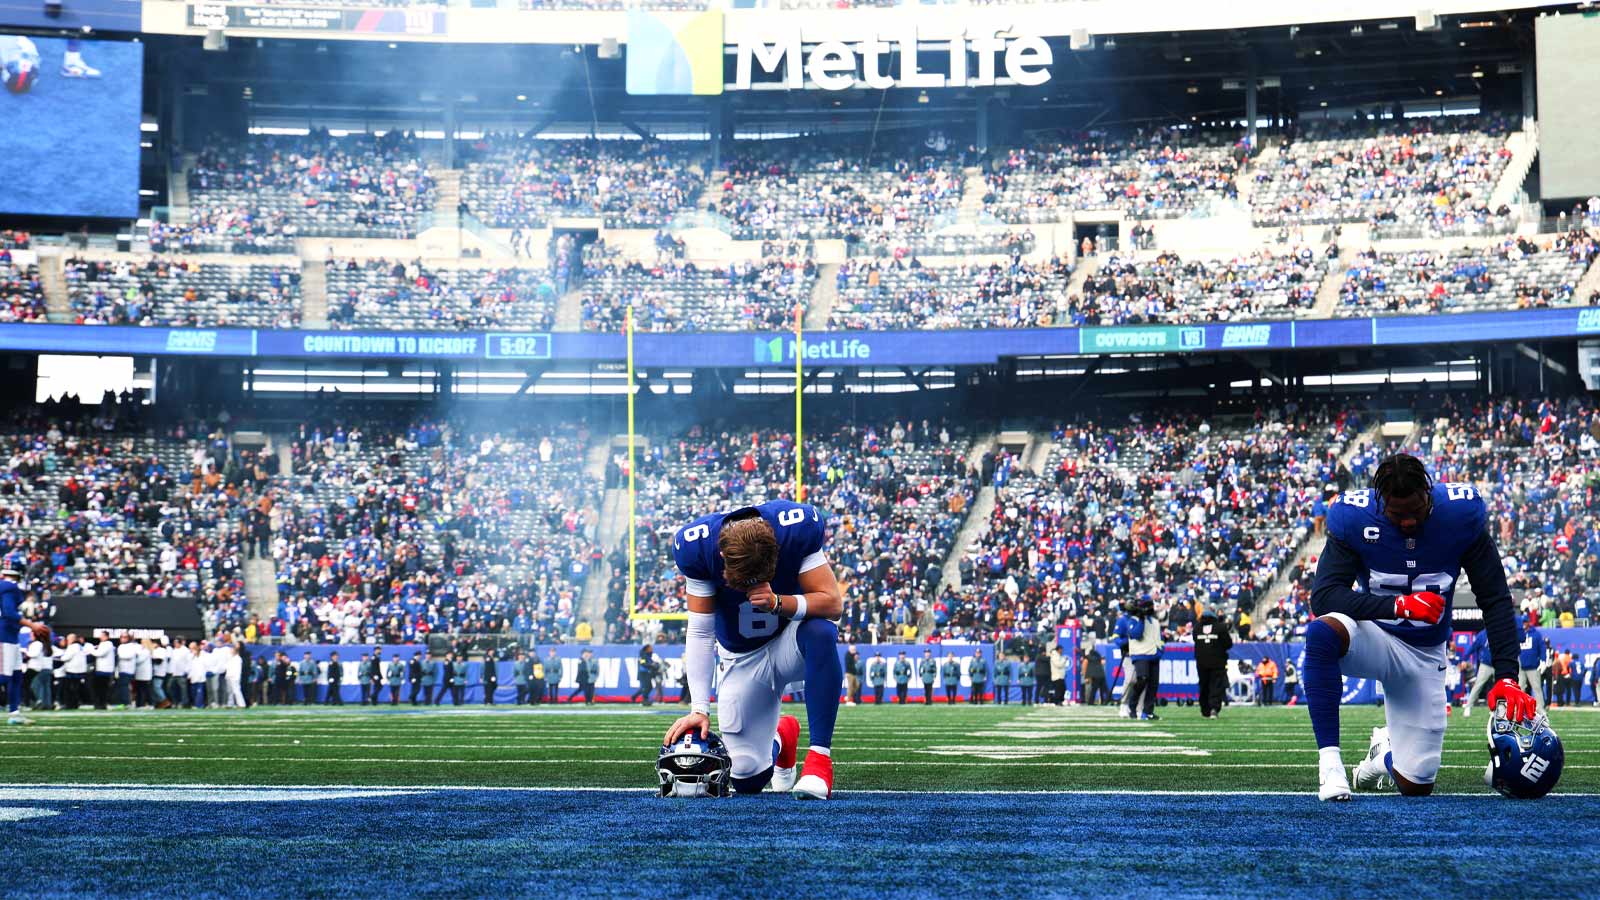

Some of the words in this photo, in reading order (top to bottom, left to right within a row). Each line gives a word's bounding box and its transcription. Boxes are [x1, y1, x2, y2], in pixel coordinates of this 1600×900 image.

[735, 24, 1053, 91] MetLife
[166, 330, 217, 350] GIANTS
[303, 335, 396, 353] COUNTDOWN
[398, 336, 417, 354] TO
[418, 337, 477, 354] KICKOFF
[1095, 332, 1167, 347] COWBOYS
[1184, 331, 1201, 346] VS
[1222, 325, 1271, 347] GIANTS
[500, 337, 537, 355] 5:02
[788, 340, 871, 359] MetLife
[1363, 526, 1380, 540] C
[738, 600, 779, 639] 6
[1452, 608, 1483, 620] STADIU
